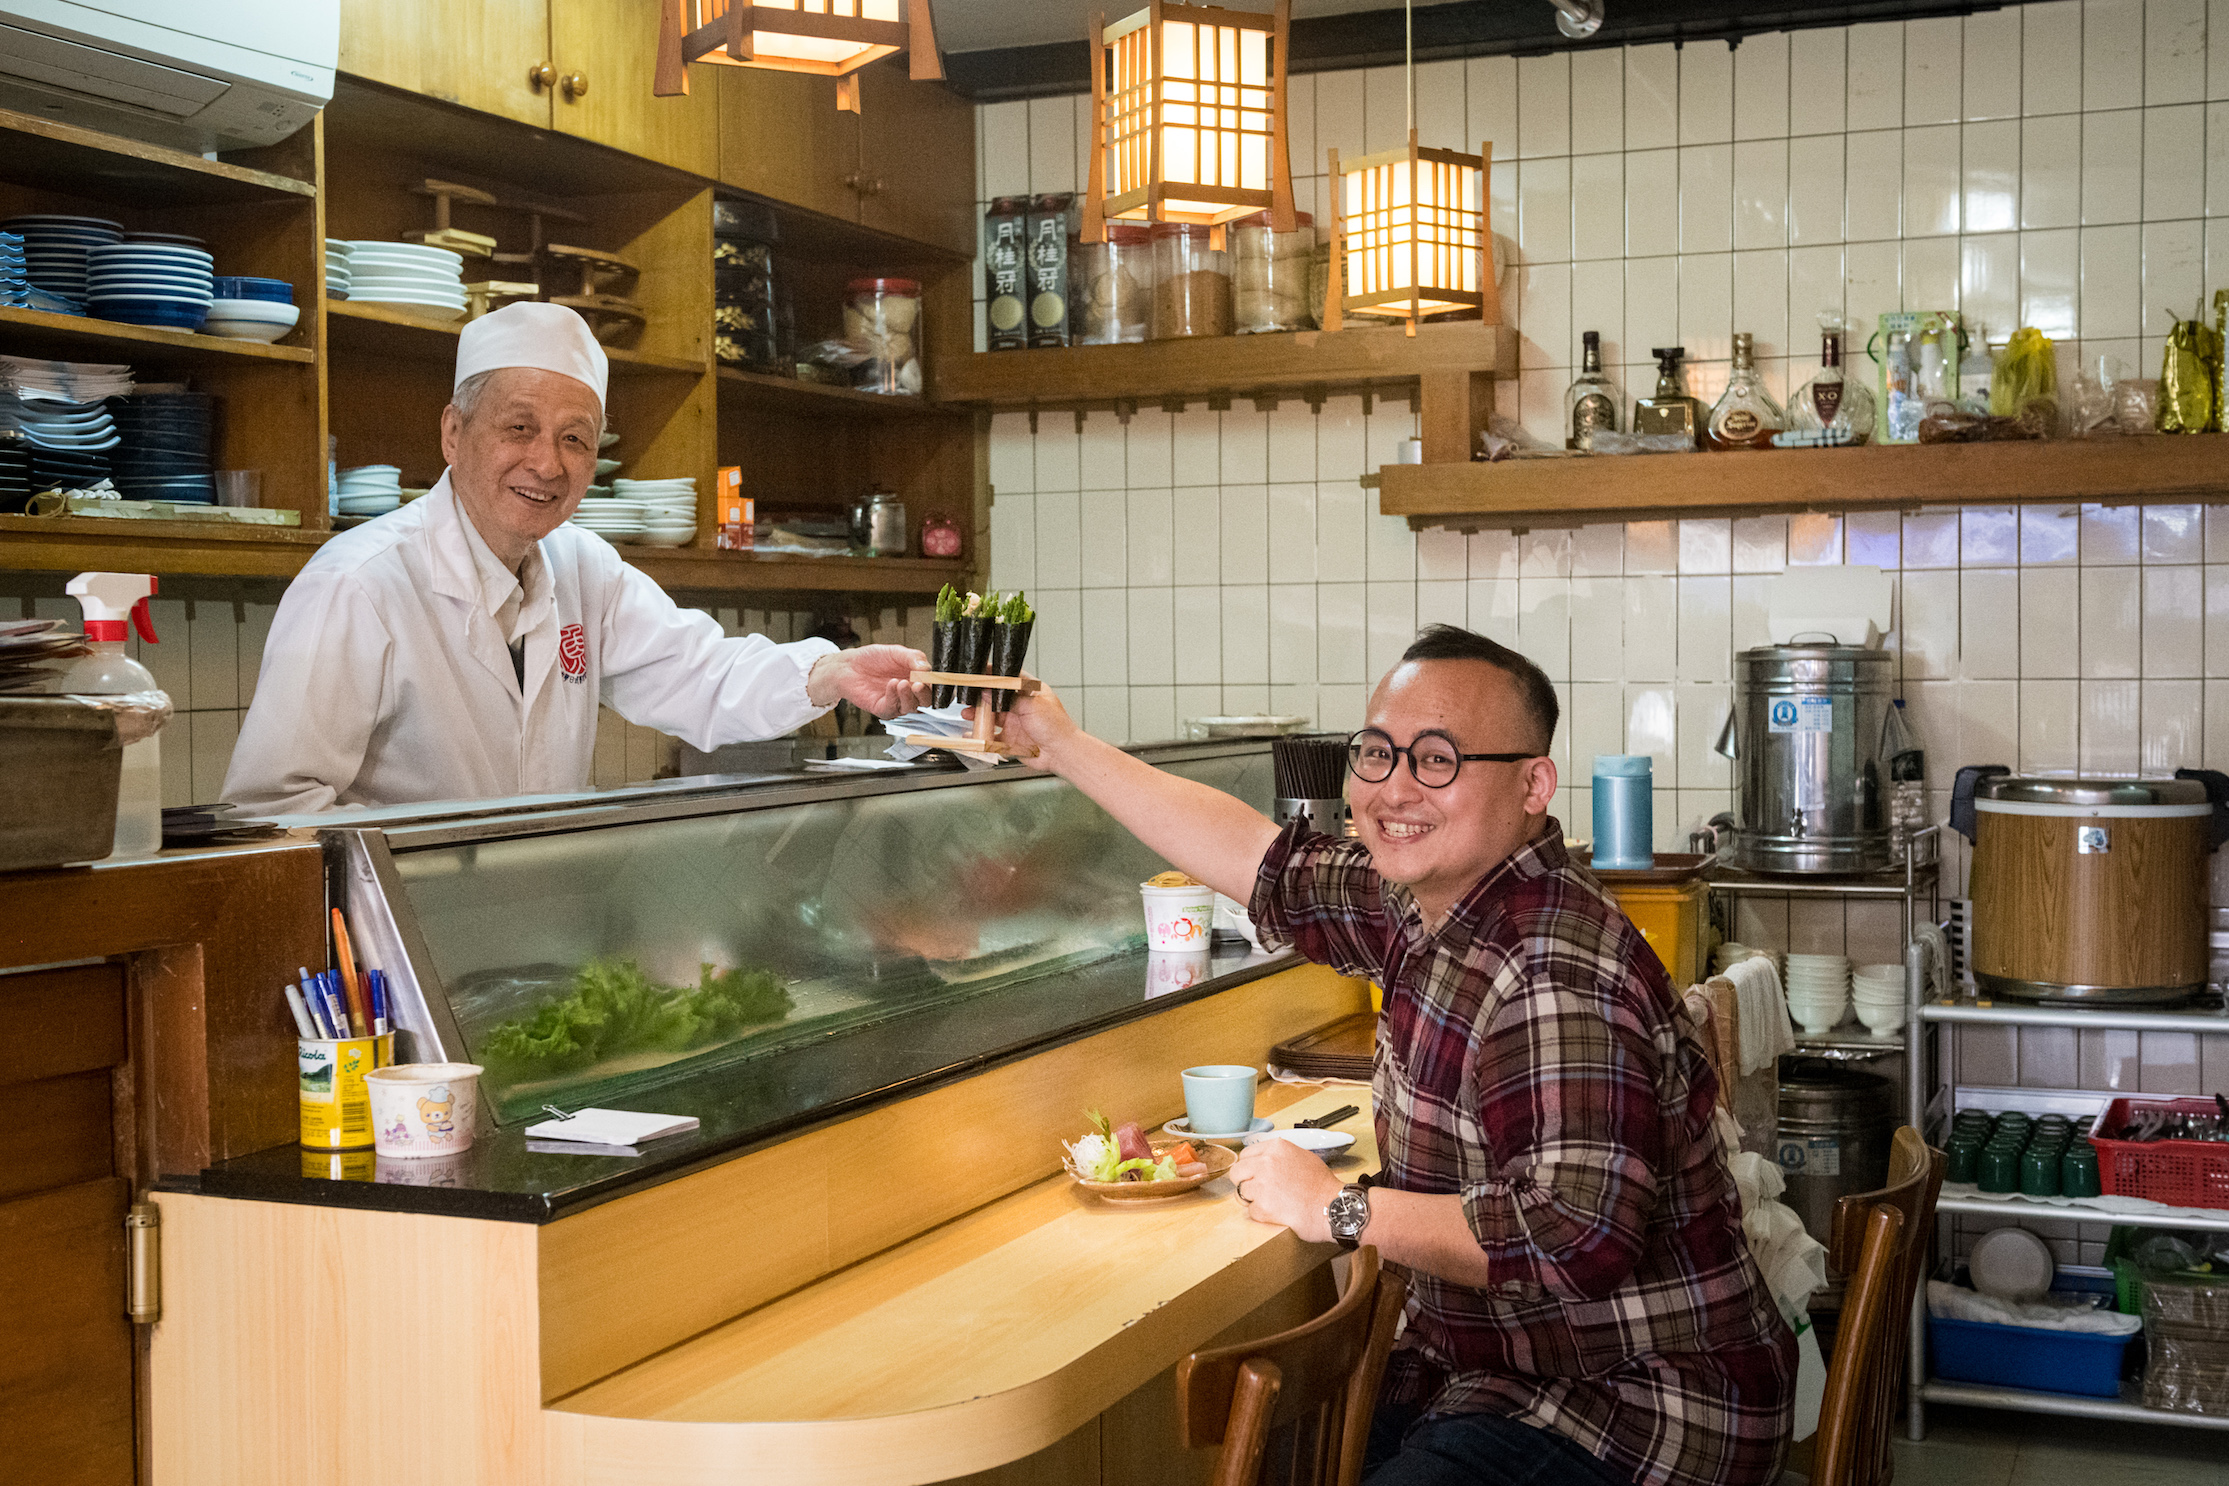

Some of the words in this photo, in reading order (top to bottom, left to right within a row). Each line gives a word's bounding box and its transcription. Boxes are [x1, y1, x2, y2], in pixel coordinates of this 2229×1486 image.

[995, 222, 1016, 294] 月桂冠
[1037, 219, 1058, 291] 月桂冠
[1817, 391, 1838, 401] XO
